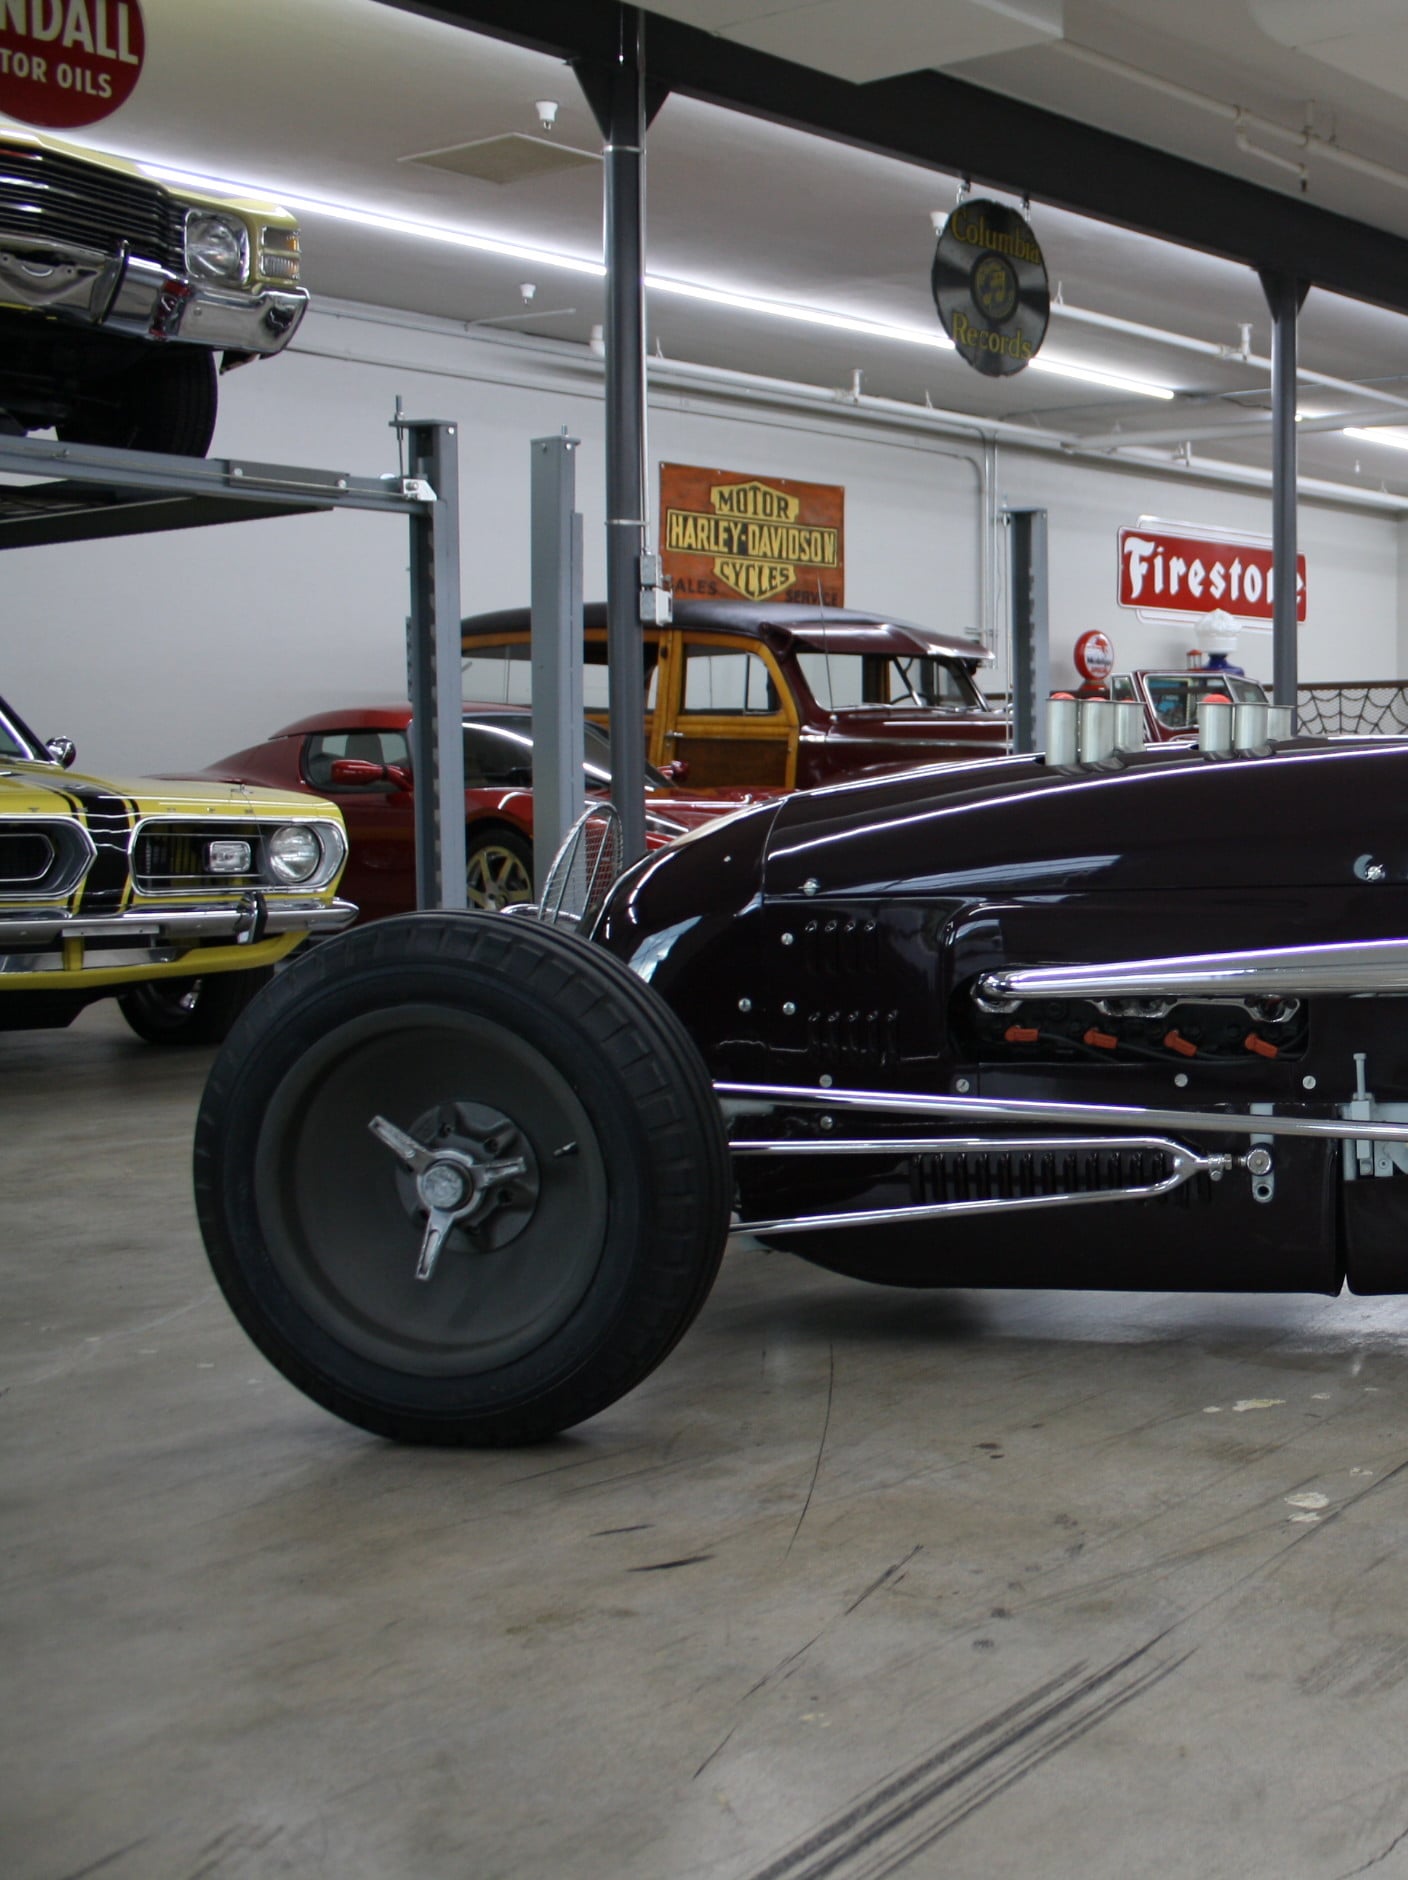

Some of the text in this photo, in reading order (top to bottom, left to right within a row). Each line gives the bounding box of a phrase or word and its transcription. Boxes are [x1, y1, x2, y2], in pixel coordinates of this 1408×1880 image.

[57, 63, 112, 98] OILS
[951, 209, 1041, 265] Columbia
[952, 311, 1034, 360] Records
[717, 485, 790, 520] MOTOR
[671, 514, 836, 563] HARLEY-DAVIDSON
[664, 577, 839, 607] ALES SERVCE
[719, 560, 790, 599] CYCLES
